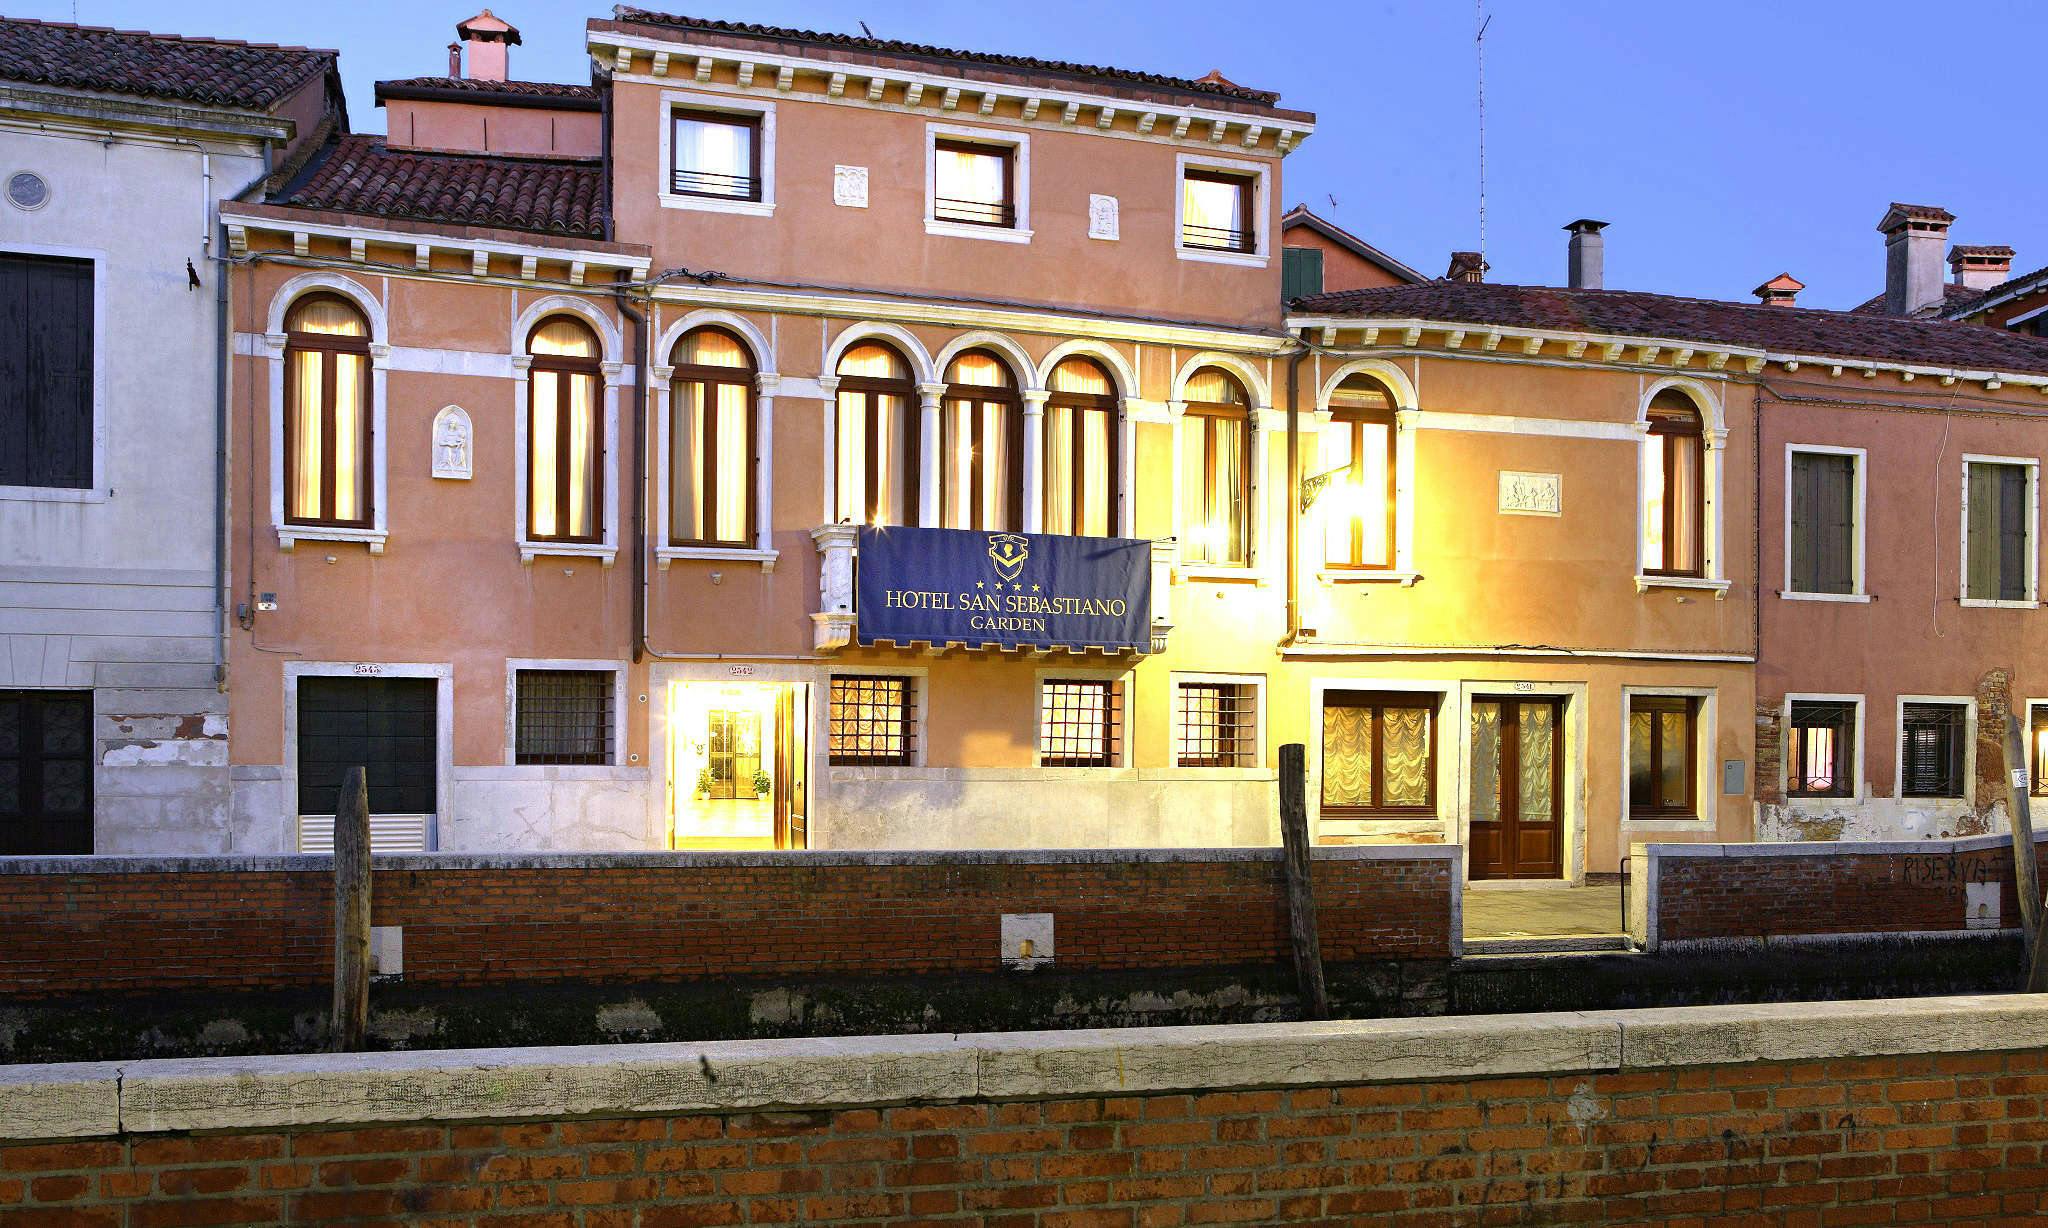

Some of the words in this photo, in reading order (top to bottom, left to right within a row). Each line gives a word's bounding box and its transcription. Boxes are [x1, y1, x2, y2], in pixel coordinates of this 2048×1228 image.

[885, 590, 955, 611] HOTEL
[959, 593, 1001, 612] SAN
[1005, 595, 1127, 617] SEBASTIANO
[970, 615, 1046, 632] GARDEN
